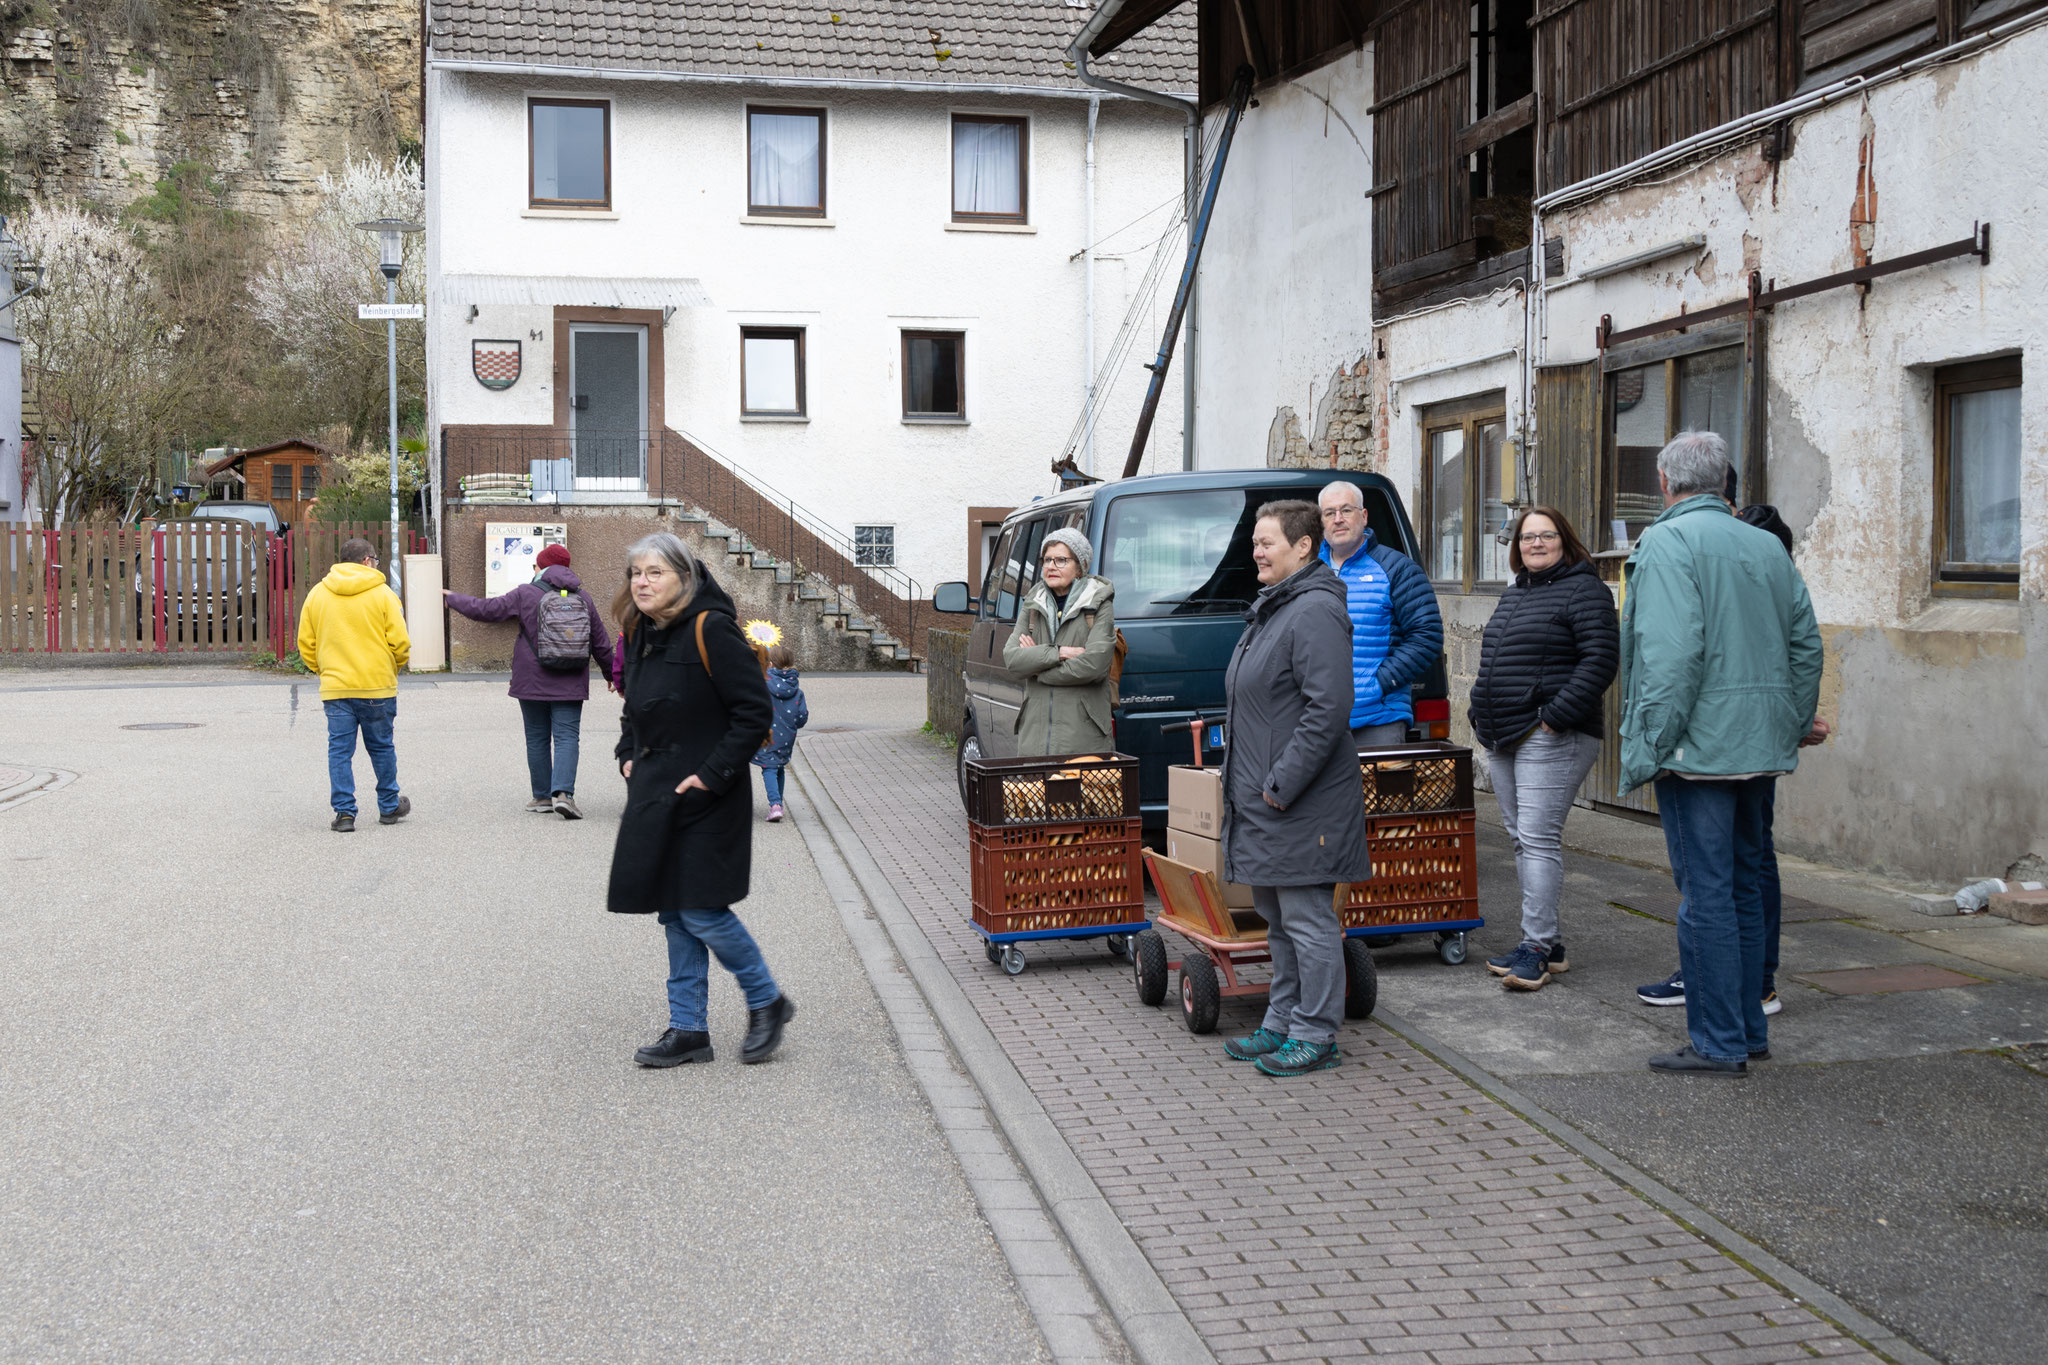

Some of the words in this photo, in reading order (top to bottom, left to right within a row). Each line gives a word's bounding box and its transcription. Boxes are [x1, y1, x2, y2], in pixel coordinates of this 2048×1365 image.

[362, 306, 420, 316] Weinbergstraße
[529, 329, 543, 341] 41
[1120, 695, 1175, 704] ultivan
